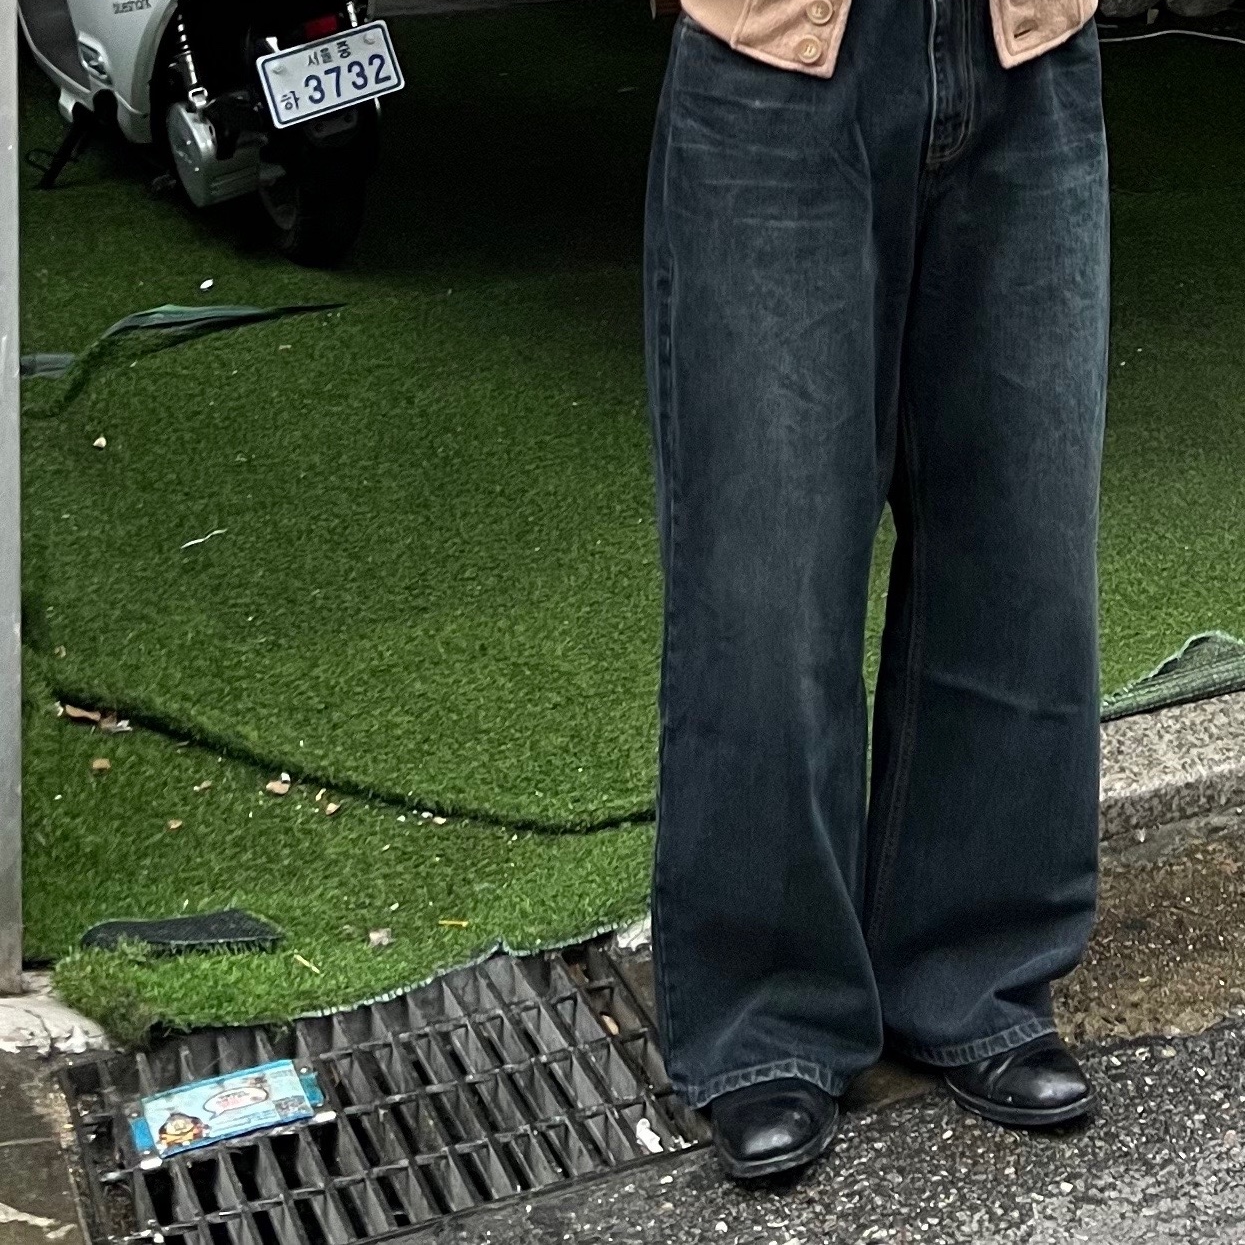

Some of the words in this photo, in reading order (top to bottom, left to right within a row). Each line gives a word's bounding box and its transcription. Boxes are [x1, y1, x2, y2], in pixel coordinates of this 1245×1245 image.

[307, 47, 332, 67] 서울
[280, 90, 300, 110] 하
[304, 54, 392, 105] 3732
